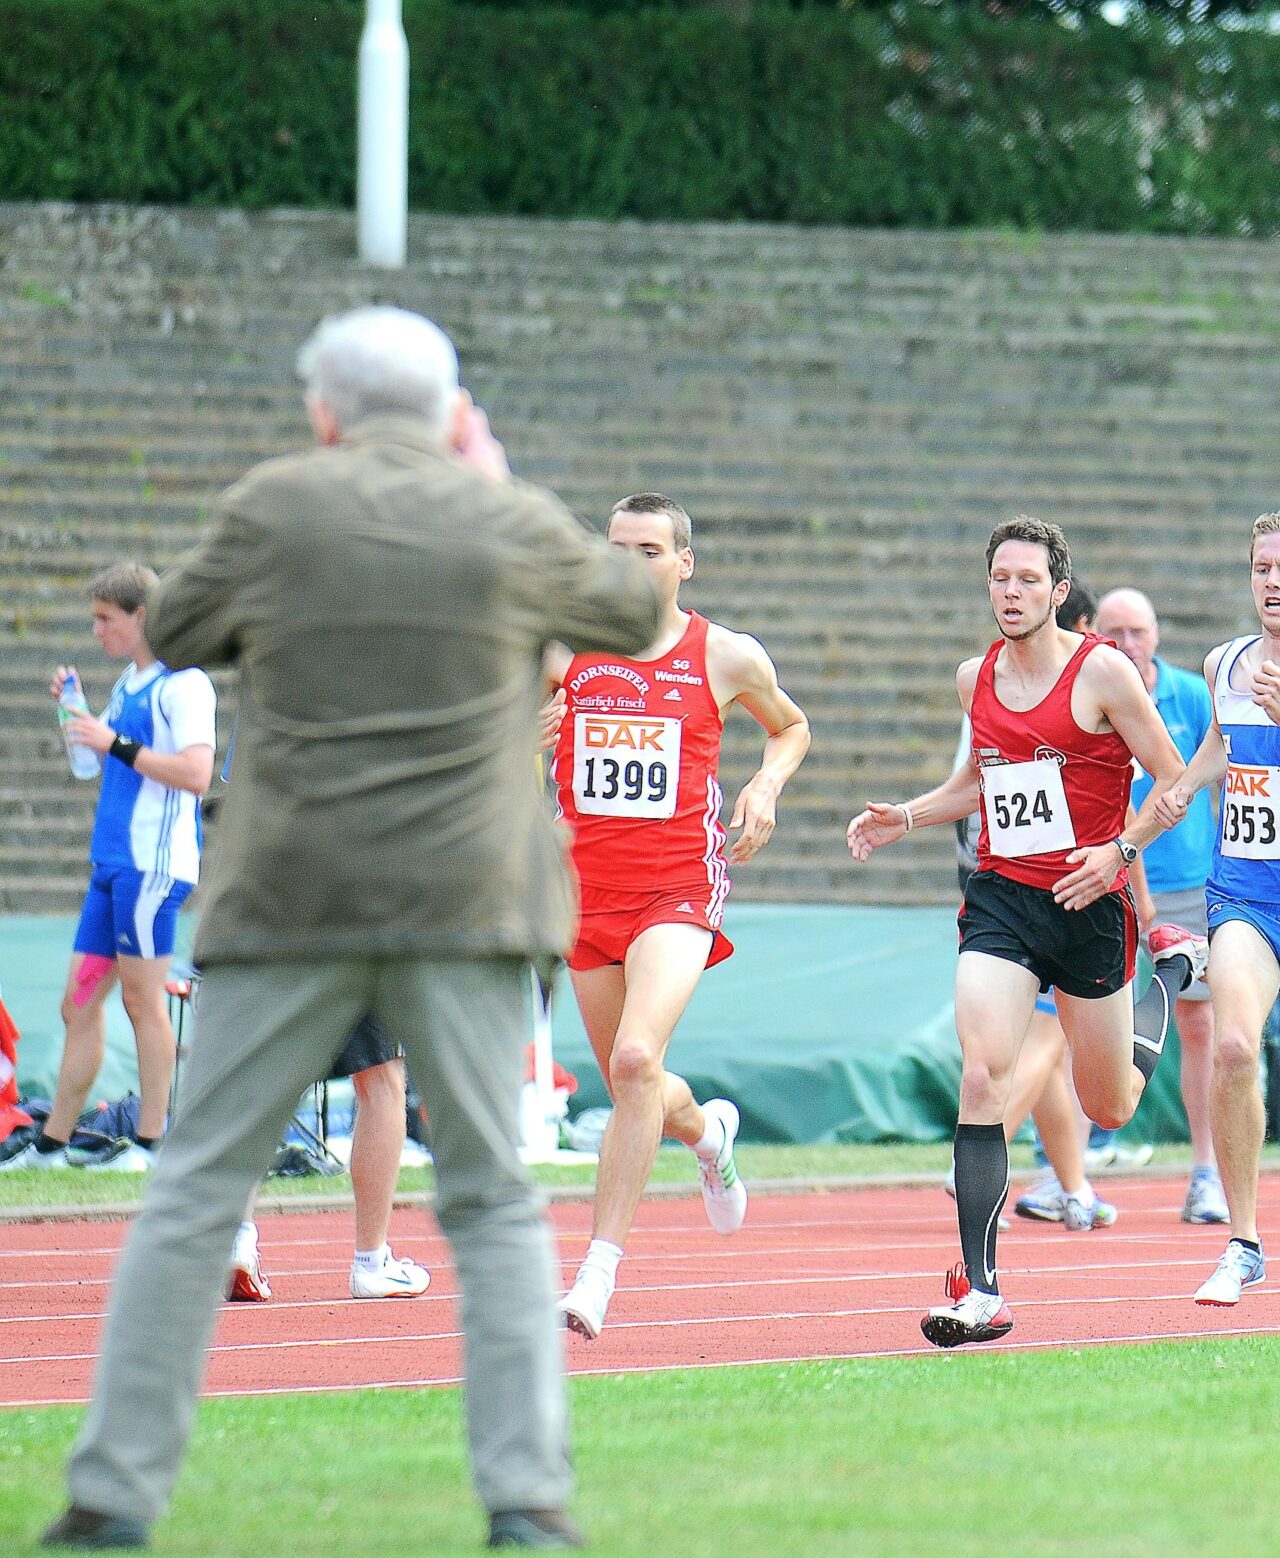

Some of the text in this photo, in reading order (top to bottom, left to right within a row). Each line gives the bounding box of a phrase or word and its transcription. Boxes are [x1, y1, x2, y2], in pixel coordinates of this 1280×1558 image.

[569, 664, 650, 696] DORNSEIFER
[654, 670, 703, 686] Wenden
[671, 659, 690, 670] SG
[616, 696, 646, 709] frisch
[585, 718, 665, 752] DAK
[583, 757, 667, 802] 1399
[994, 789, 1053, 829] 524
